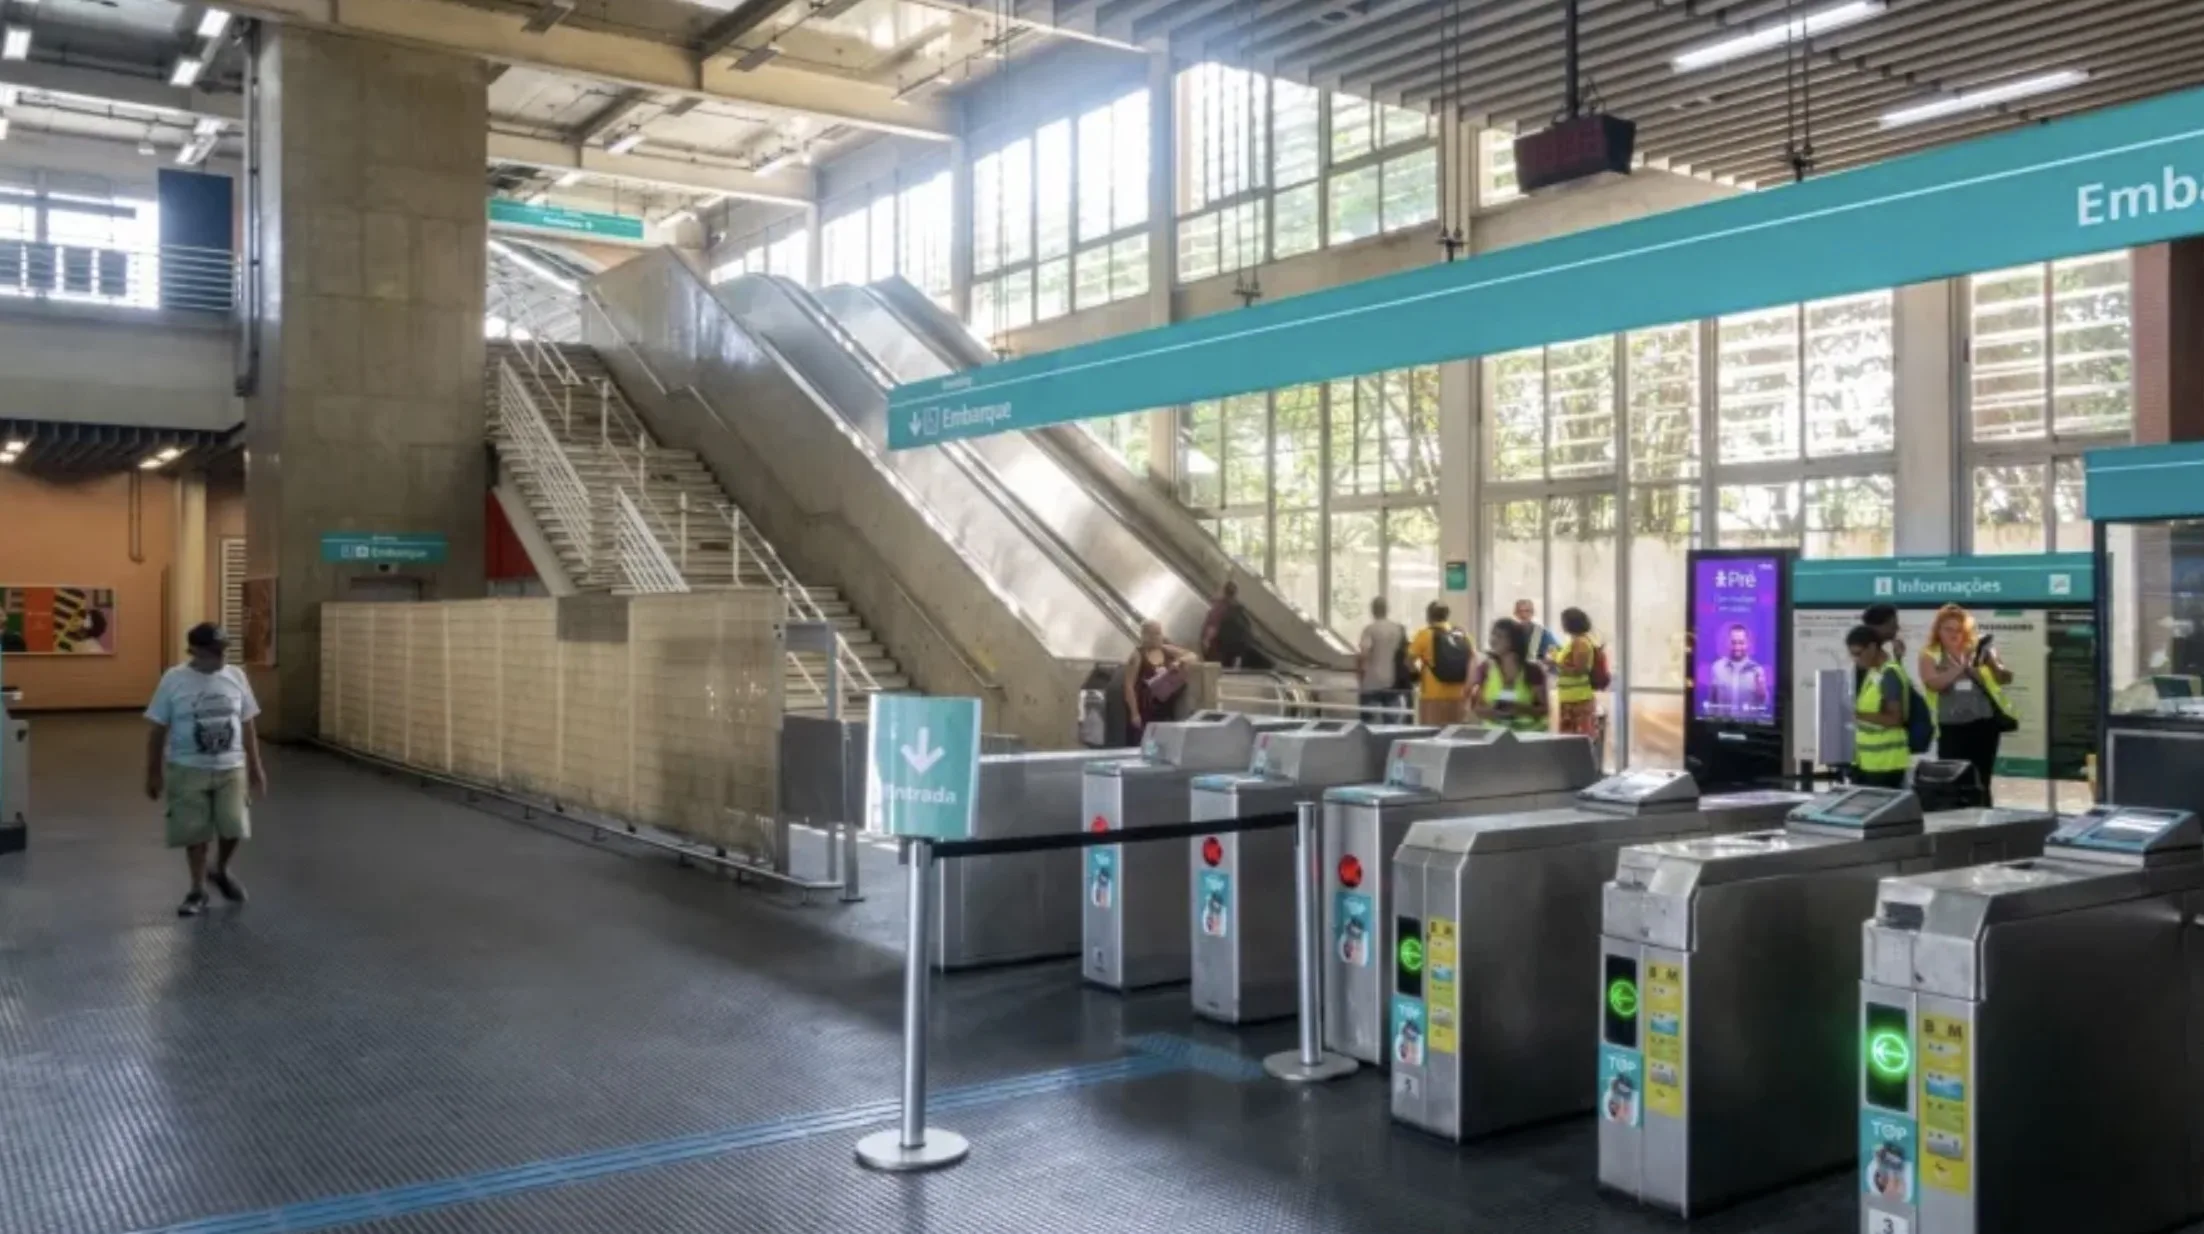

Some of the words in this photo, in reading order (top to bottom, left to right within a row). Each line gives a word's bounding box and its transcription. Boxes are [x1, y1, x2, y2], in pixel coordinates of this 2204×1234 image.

[2078, 164, 2204, 226] Emb
[942, 402, 1012, 428] Embarque
[1898, 578, 2001, 598] Informações
[1871, 1119, 1908, 1140] TOP
